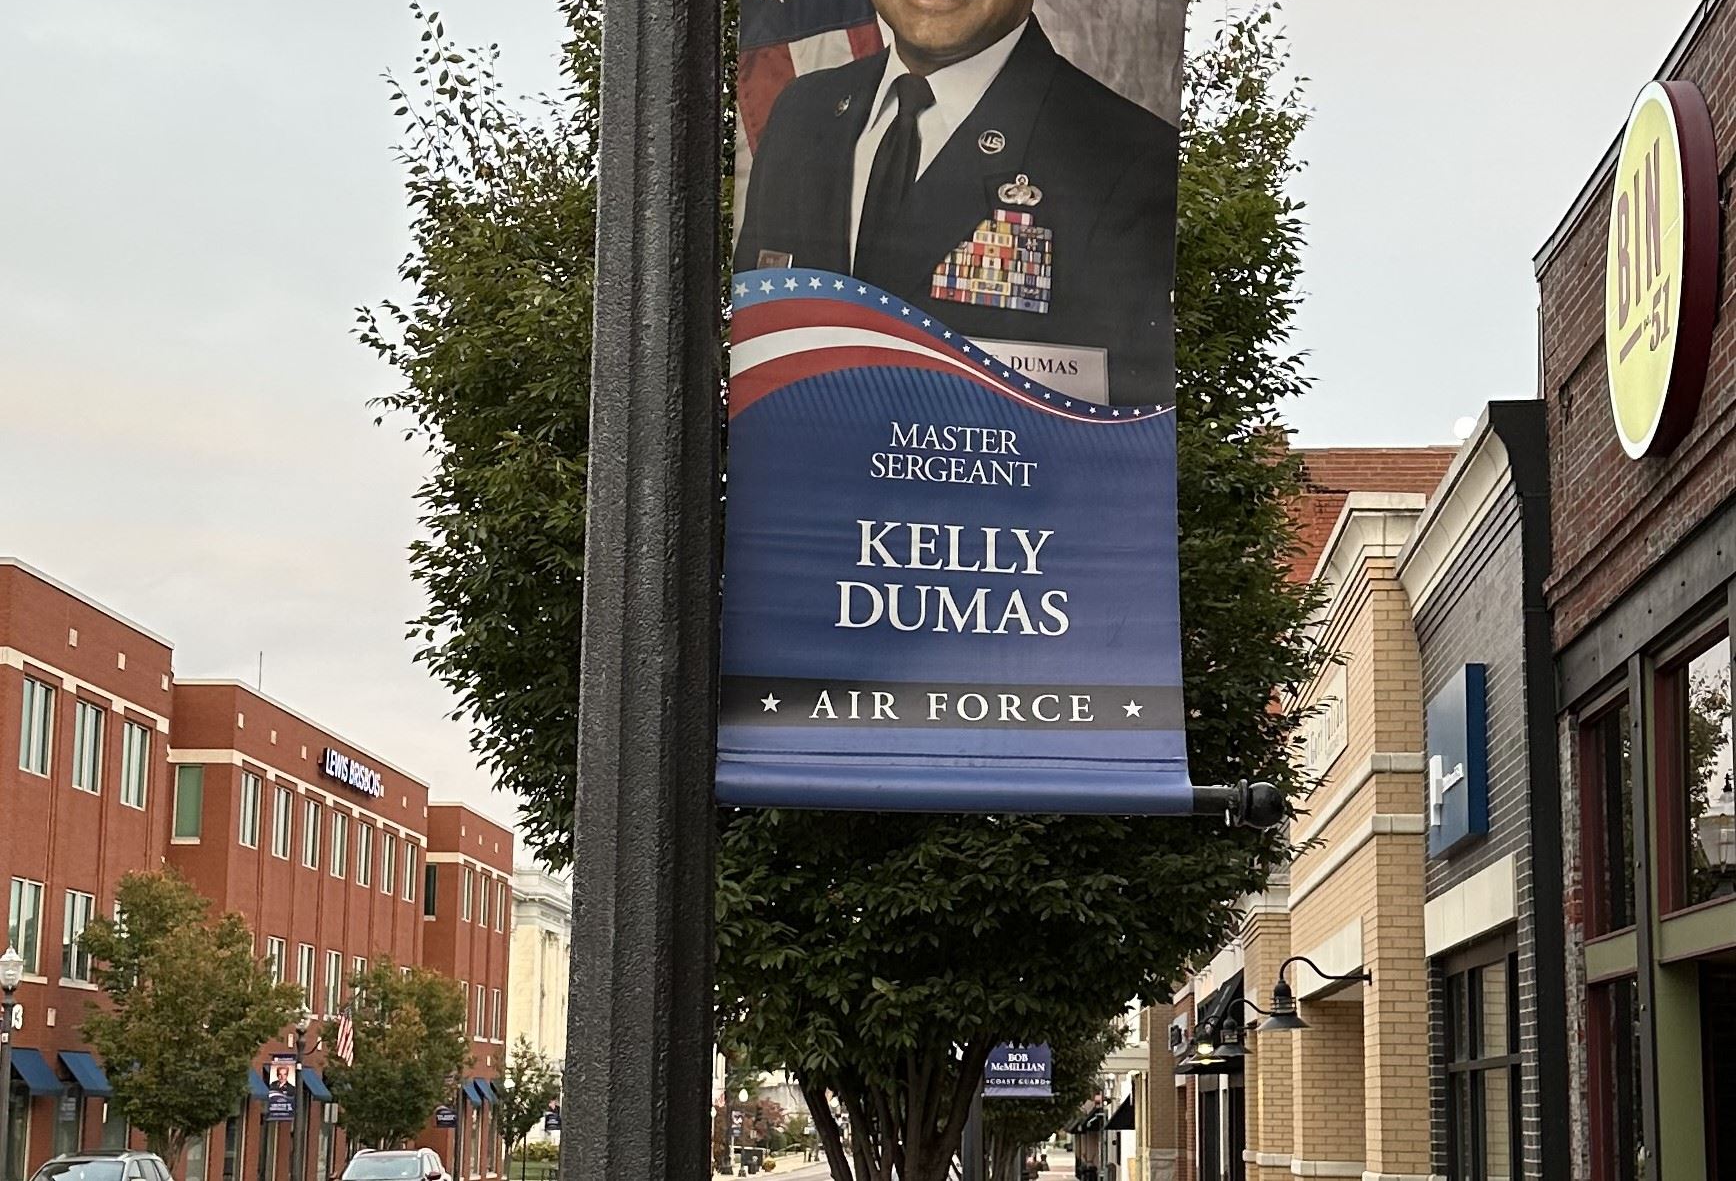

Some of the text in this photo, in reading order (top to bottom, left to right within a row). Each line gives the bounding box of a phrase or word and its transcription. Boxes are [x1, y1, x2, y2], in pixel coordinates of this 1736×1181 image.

[1617, 136, 1661, 331] BIN
[1650, 273, 1671, 351] 51
[1011, 355, 1079, 376] DUMAS
[889, 421, 1021, 456] MASTER
[870, 452, 1038, 488] SERGEANT
[856, 519, 1054, 575] KELLY
[834, 580, 1070, 636] DUMAS
[809, 690, 1096, 723] AIR FORCE
[1007, 1053, 1028, 1062] BOB
